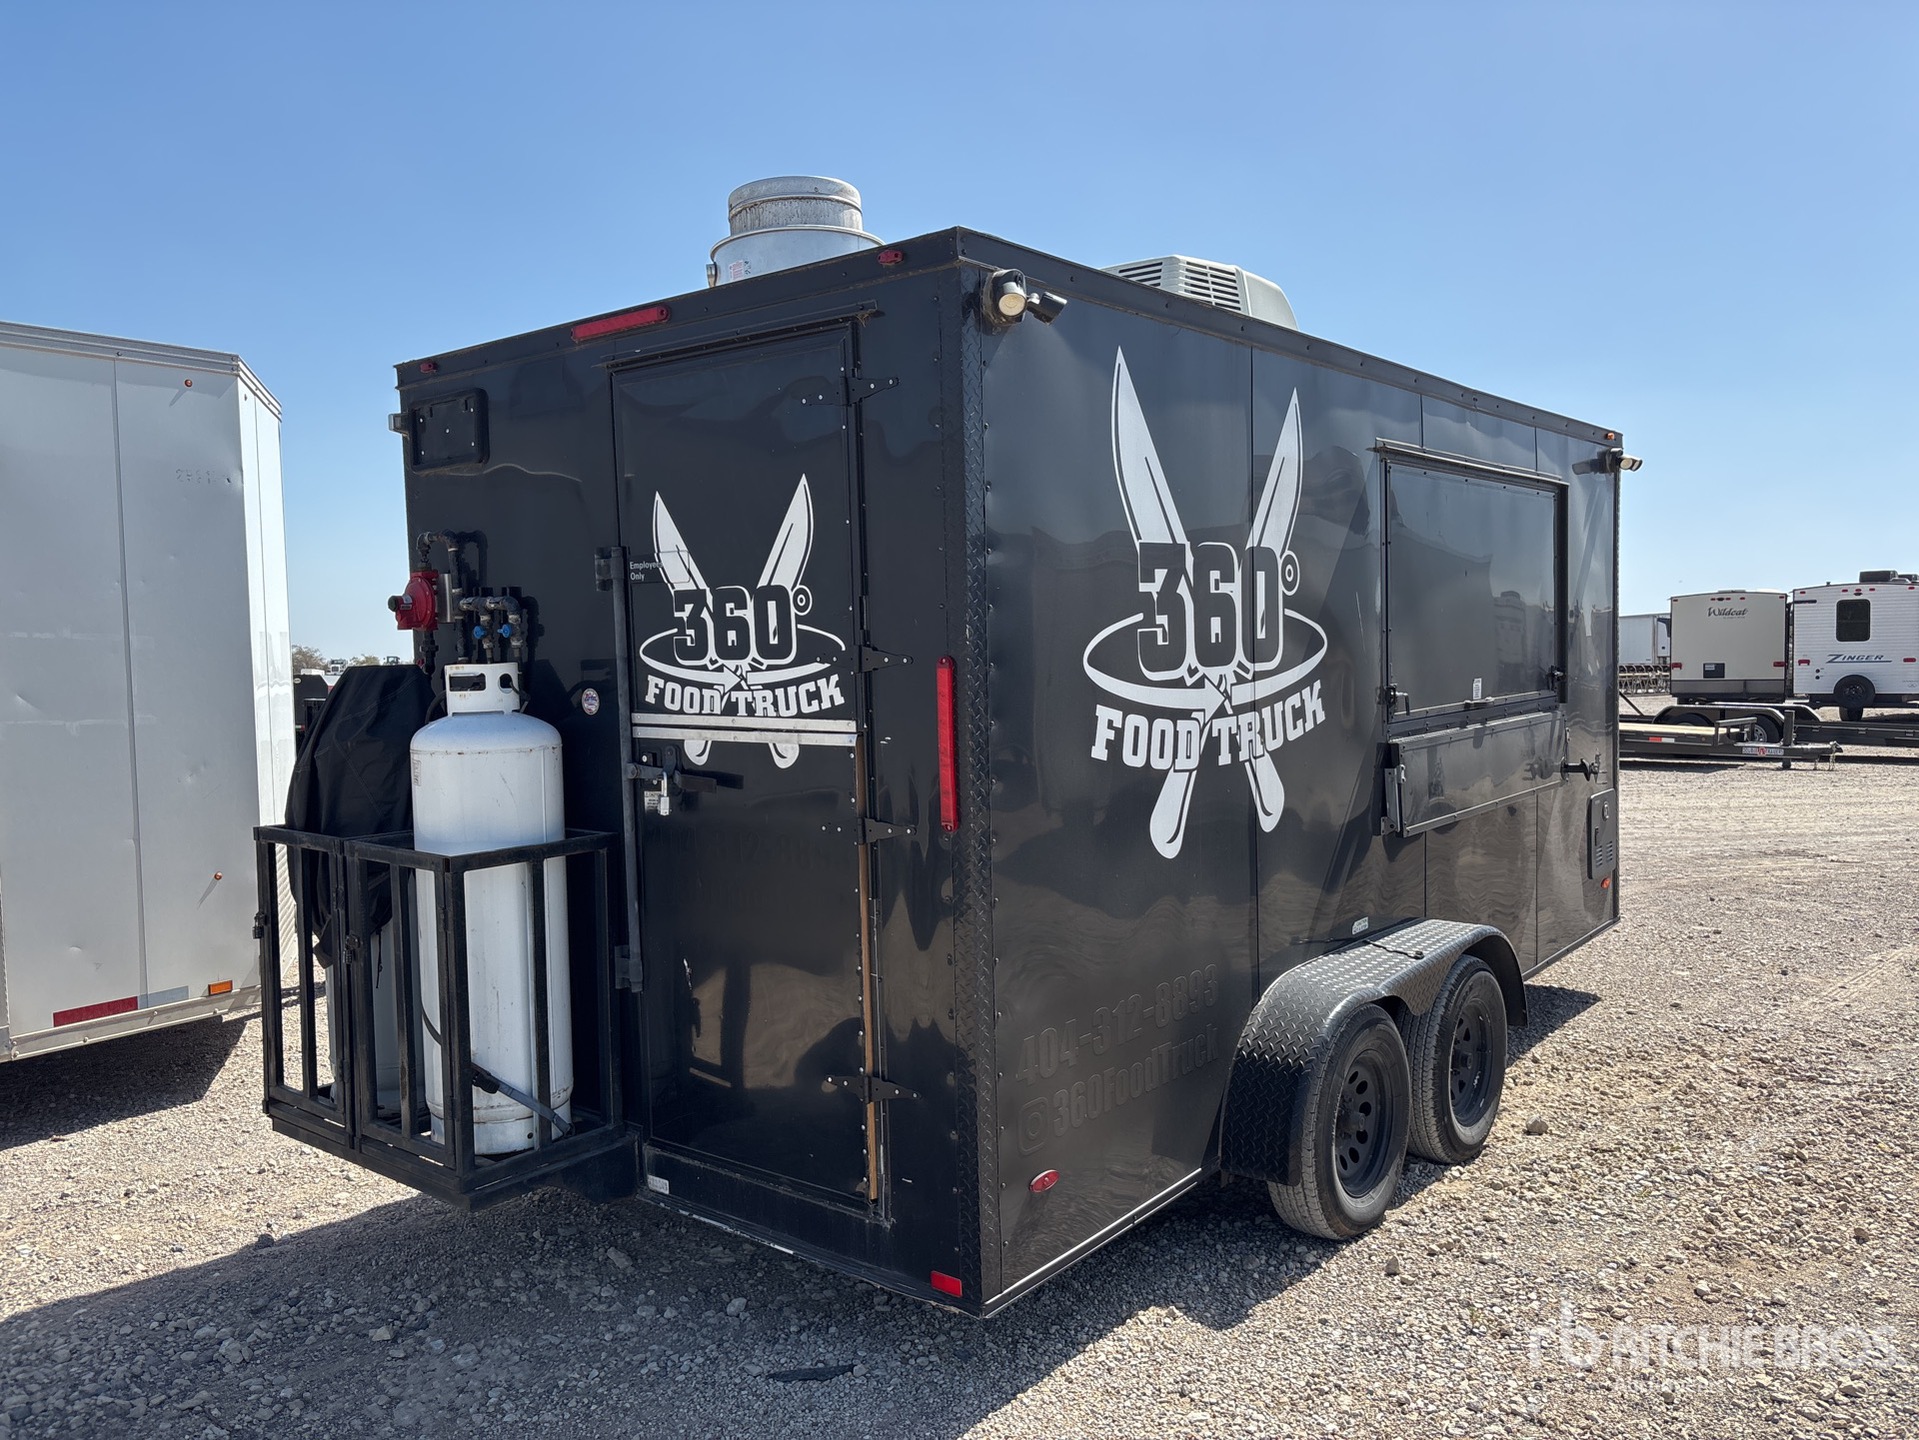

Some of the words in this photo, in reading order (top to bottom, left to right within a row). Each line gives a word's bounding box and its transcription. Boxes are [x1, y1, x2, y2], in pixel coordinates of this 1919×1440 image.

[630, 571, 646, 582] Only
[1707, 606, 1749, 618] Wildcat
[1825, 653, 1887, 664] ZINGER
[645, 674, 724, 715] FOOD
[730, 673, 845, 718] TRUCK
[1091, 704, 1201, 771] FOOD
[1212, 679, 1326, 766] TRUCK
[1016, 963, 1220, 1086] 404-312-8893
